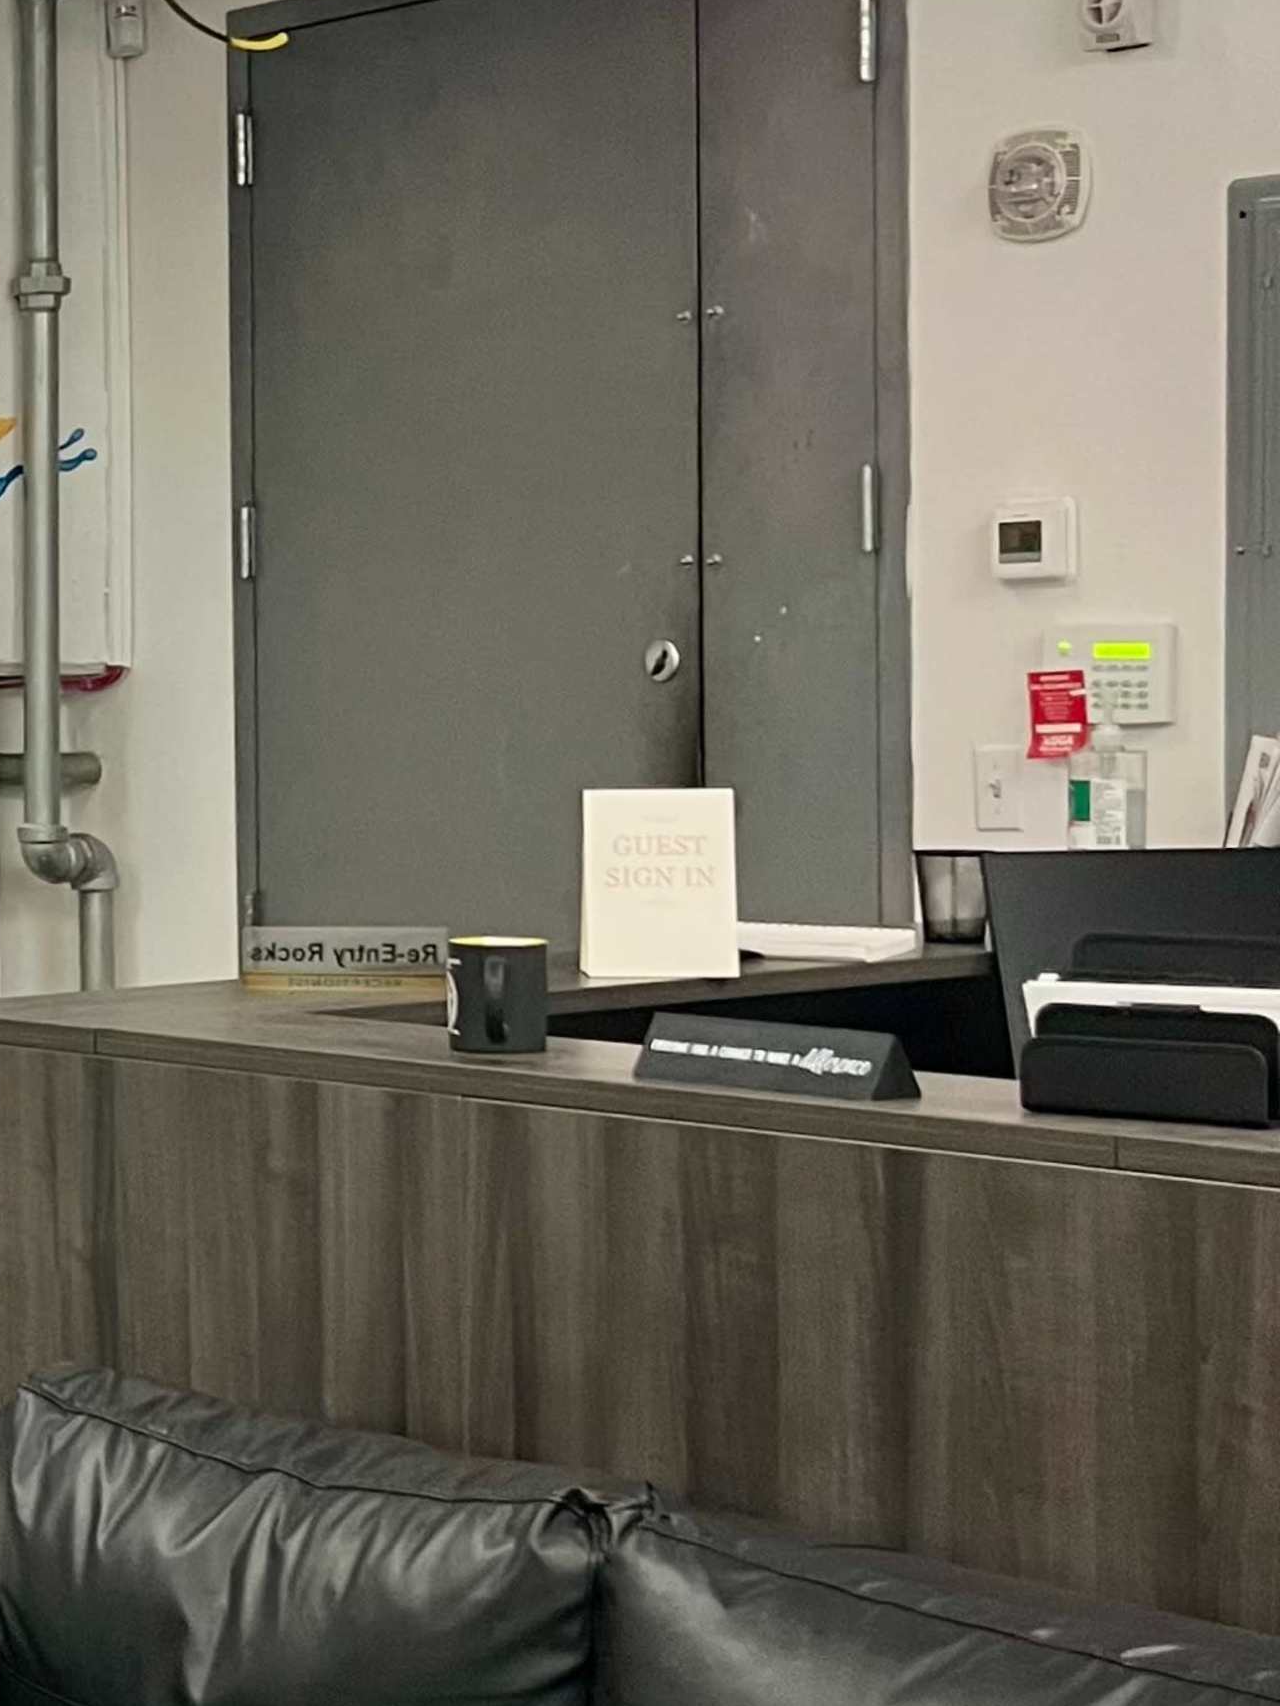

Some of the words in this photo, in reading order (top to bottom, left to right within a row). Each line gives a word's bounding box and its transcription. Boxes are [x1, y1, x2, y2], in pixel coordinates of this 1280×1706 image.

[612, 833, 708, 857] GUEST
[604, 866, 676, 888] SIGN
[684, 865, 716, 887] IN
